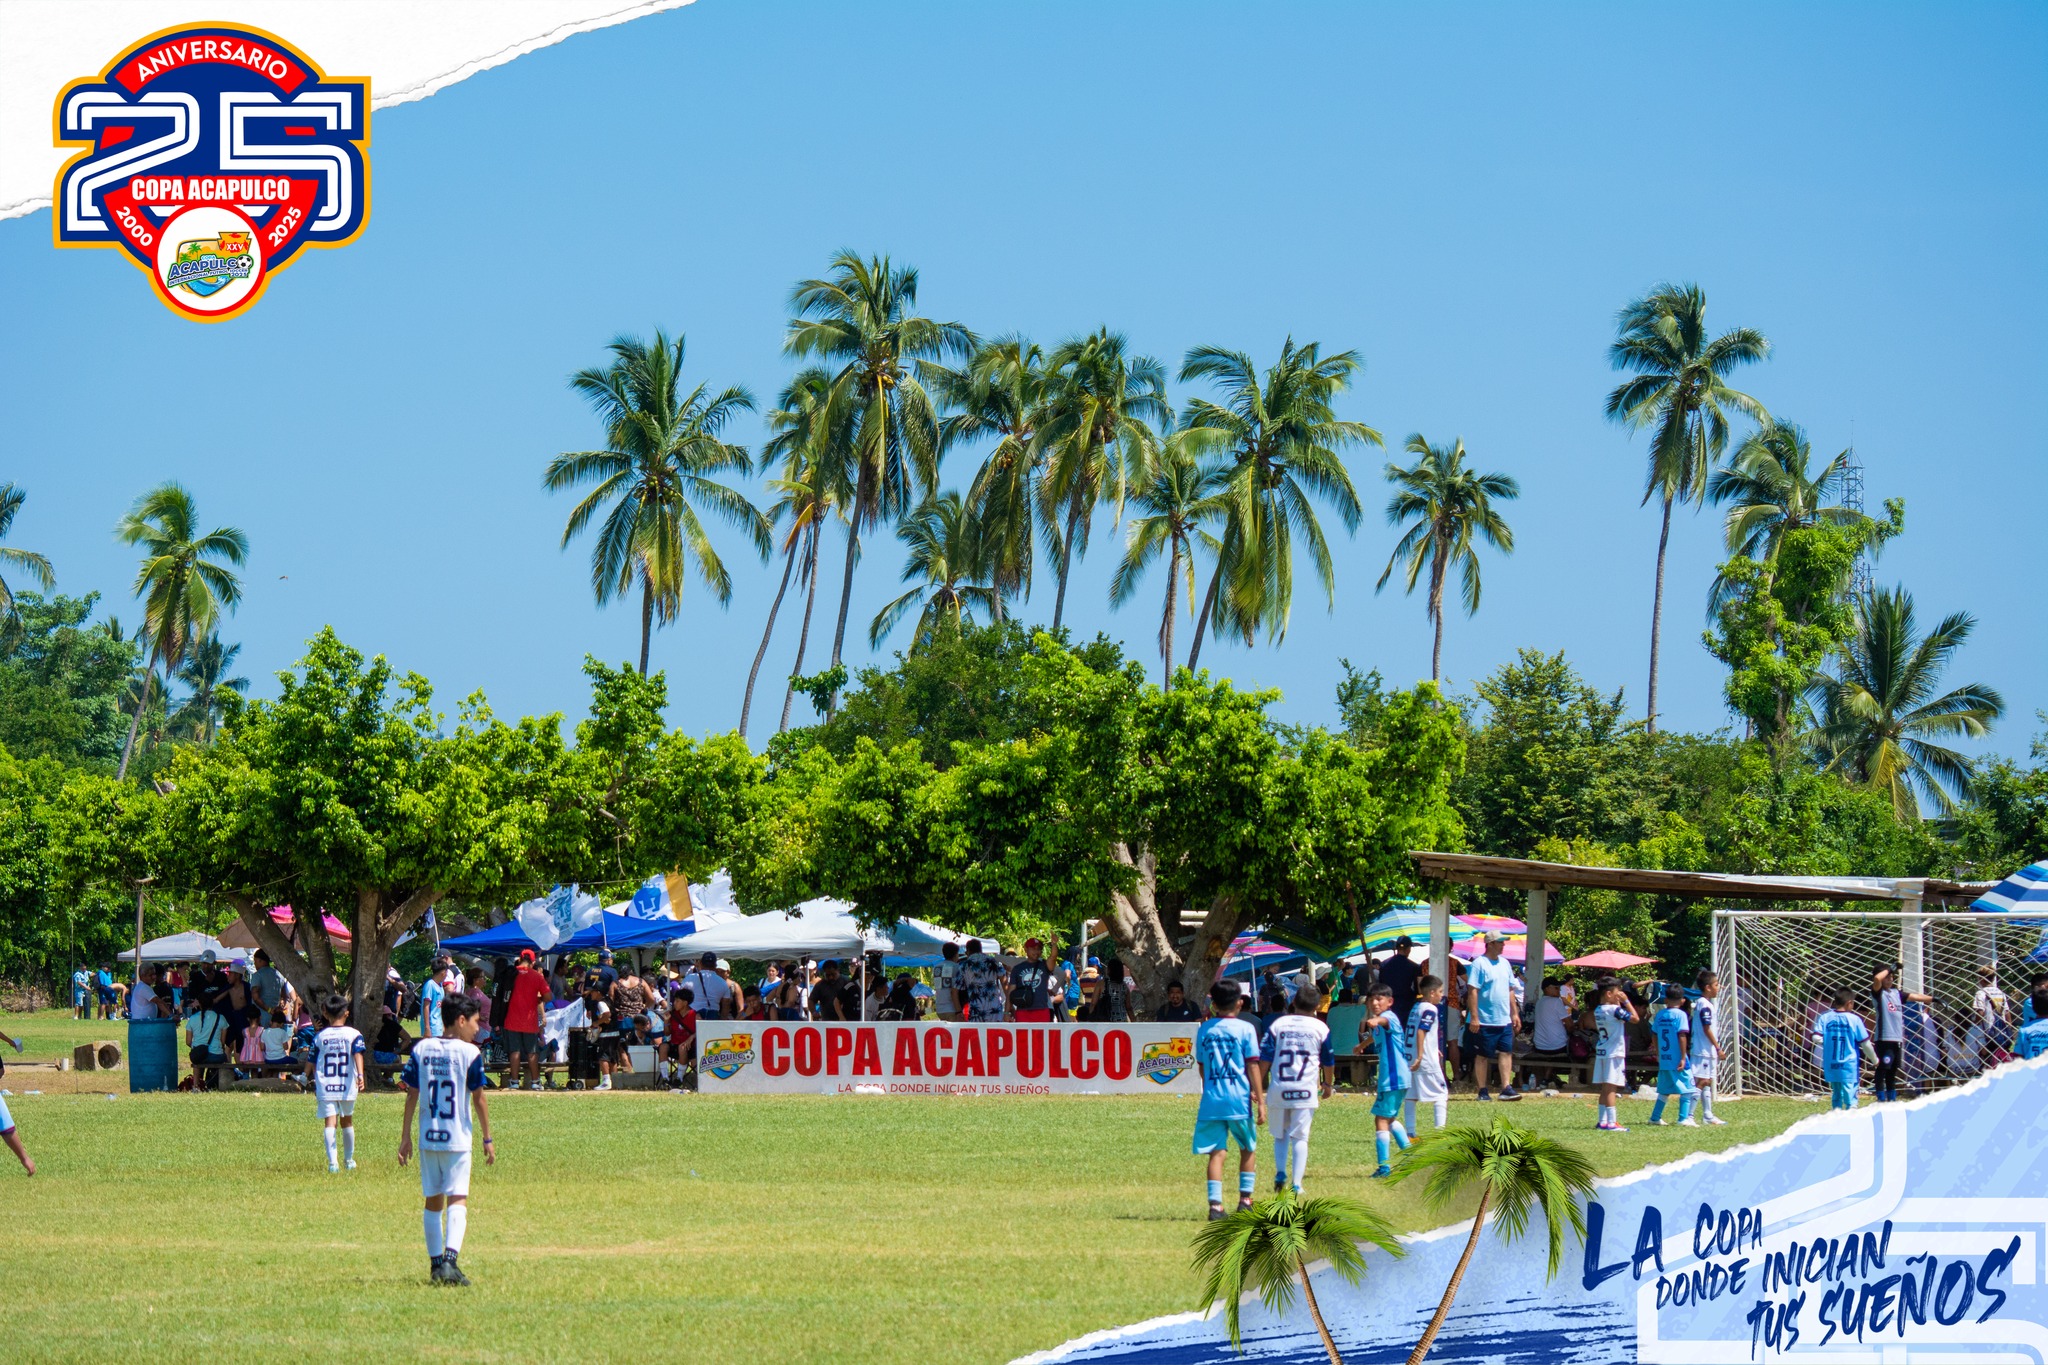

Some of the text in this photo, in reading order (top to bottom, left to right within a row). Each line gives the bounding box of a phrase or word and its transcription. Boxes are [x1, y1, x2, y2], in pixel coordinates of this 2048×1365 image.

[761, 1026, 1132, 1081] COPA ACAPULCO
[1661, 1029, 1670, 1051] 5
[324, 1052, 349, 1077] 62
[1208, 1052, 1238, 1086] 44
[1278, 1050, 1310, 1081] 27
[838, 1083, 852, 1093] LA
[890, 1083, 931, 1093] DONDE
[934, 1083, 977, 1094] INICIAN
[980, 1084, 1001, 1094] TUS
[1004, 1083, 1050, 1095] SUEÑOS
